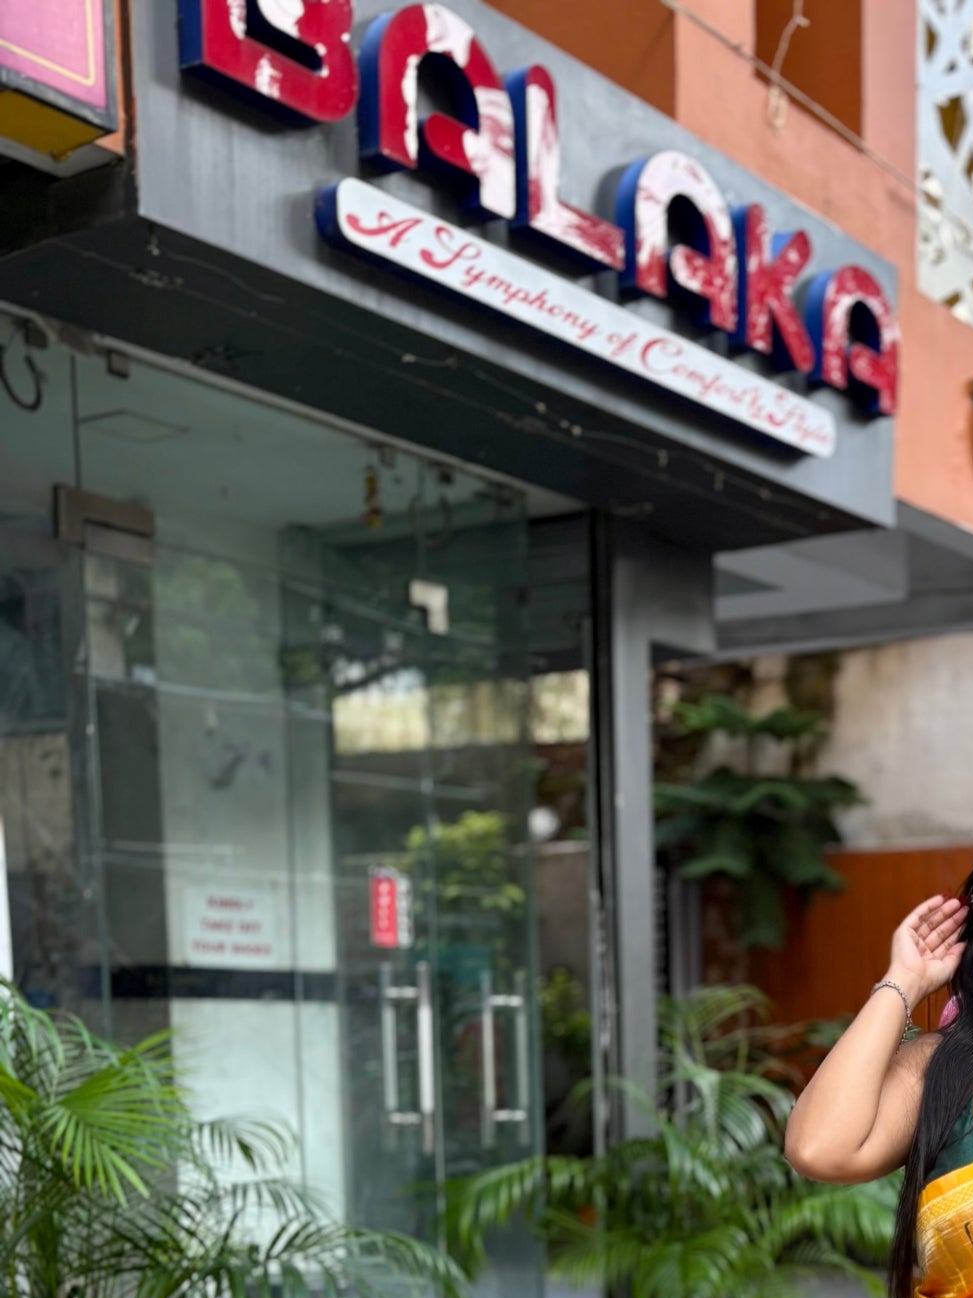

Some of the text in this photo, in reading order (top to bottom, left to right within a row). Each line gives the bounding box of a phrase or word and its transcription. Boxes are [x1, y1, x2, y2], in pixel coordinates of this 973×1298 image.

[345, 210, 423, 249] A
[419, 225, 600, 340] Symphony
[606, 331, 639, 358] of
